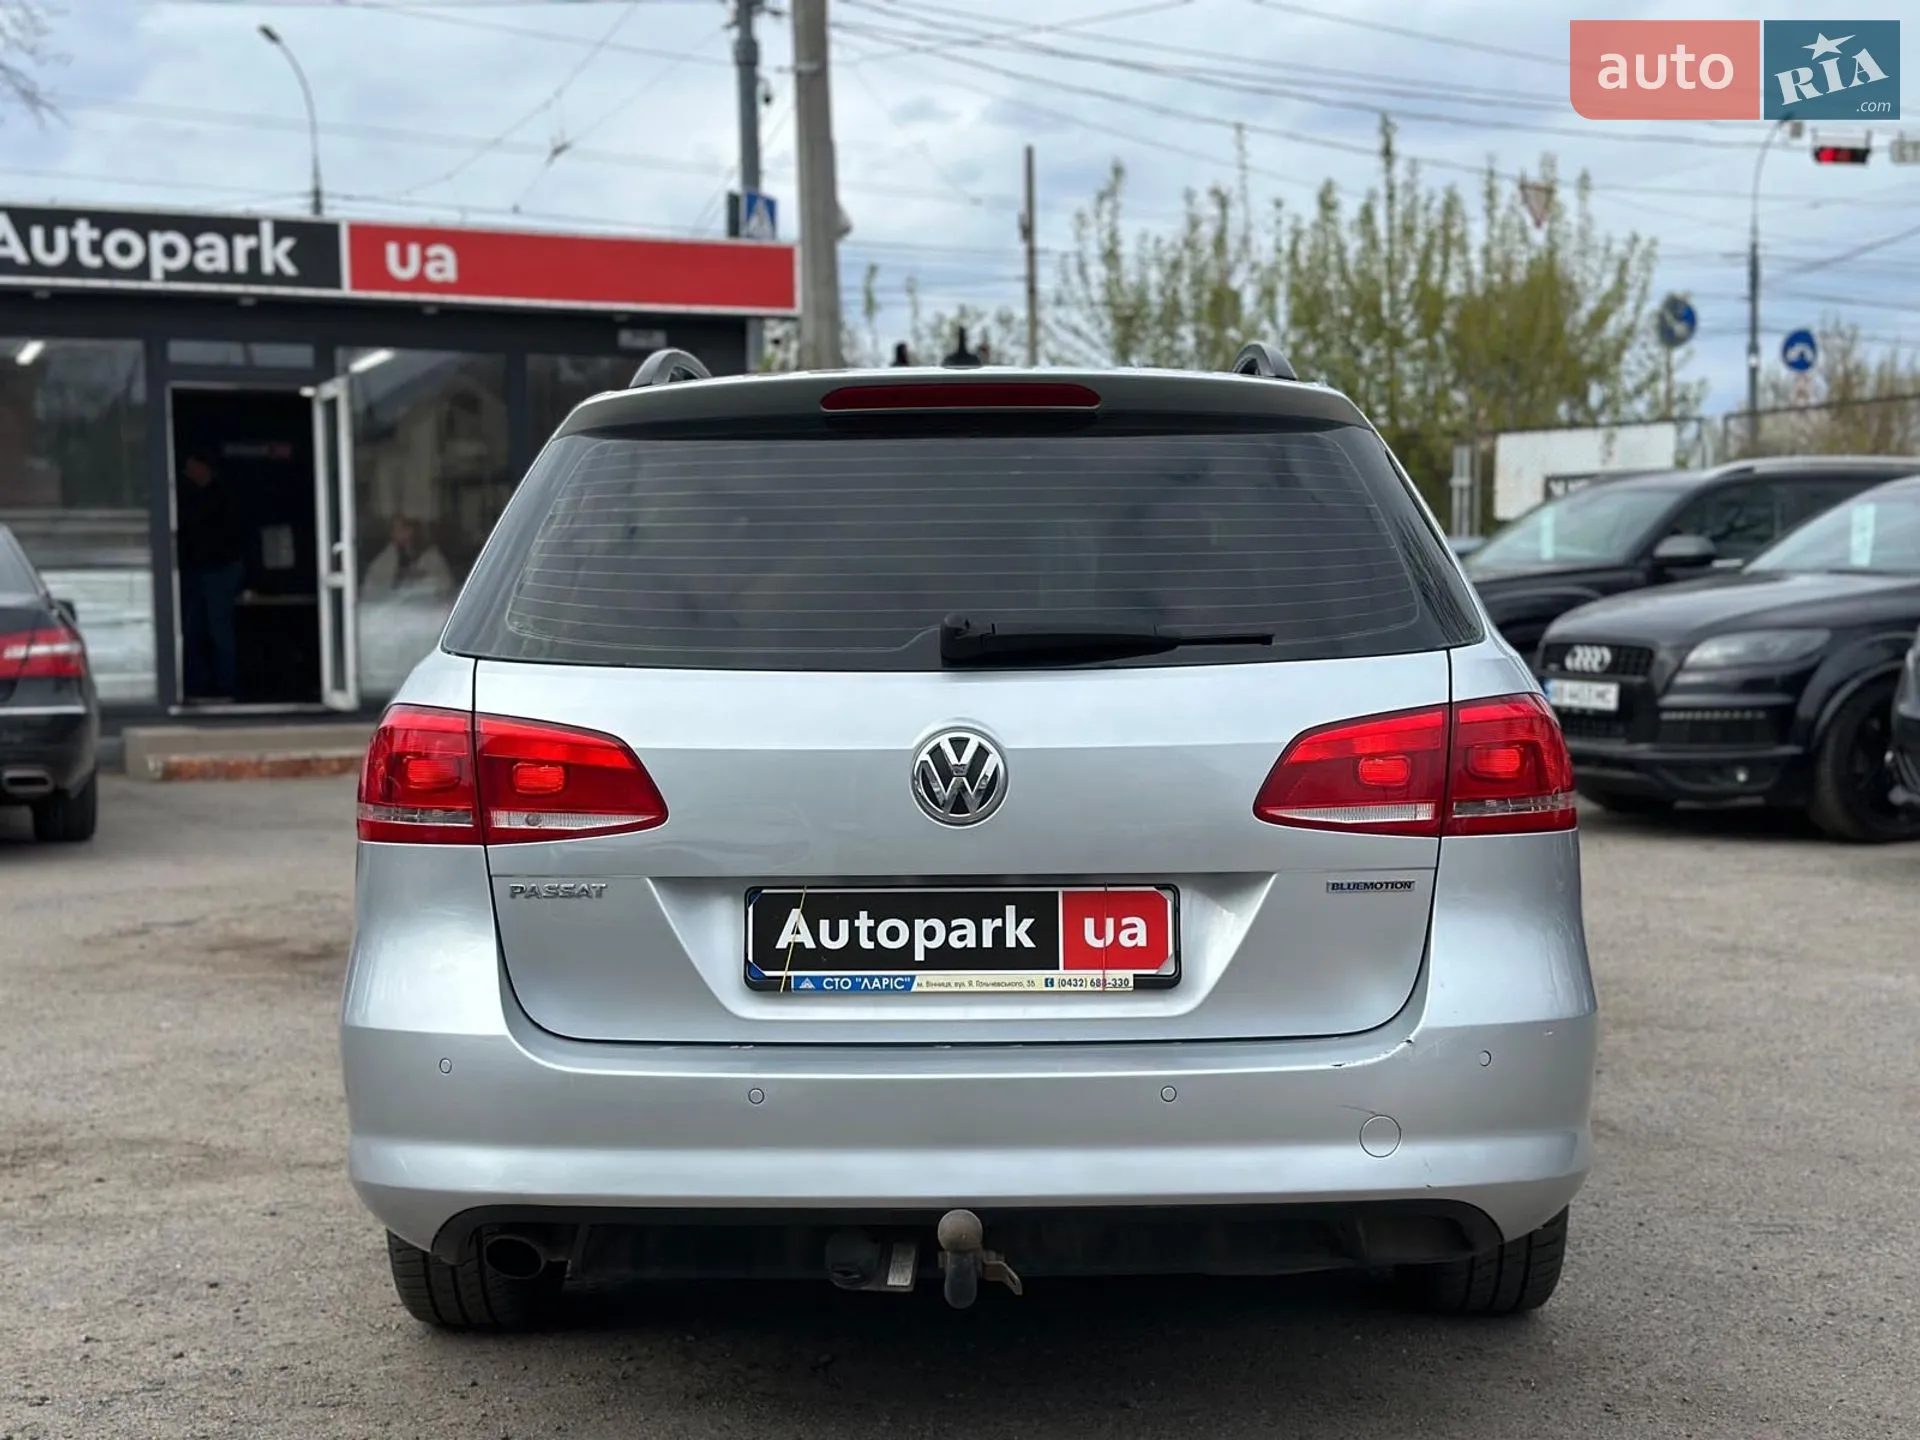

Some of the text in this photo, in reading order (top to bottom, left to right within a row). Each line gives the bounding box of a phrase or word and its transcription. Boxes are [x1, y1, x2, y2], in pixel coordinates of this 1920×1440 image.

[0, 211, 459, 284] Autopark ua
[508, 883, 608, 900] PASSAT
[1330, 881, 1414, 892] BLUEMOTION
[775, 905, 1148, 961] Autopark ua
[822, 977, 852, 990] СТО
[855, 977, 911, 990] "ЛАРІС"
[1058, 978, 1087, 989] (0432)
